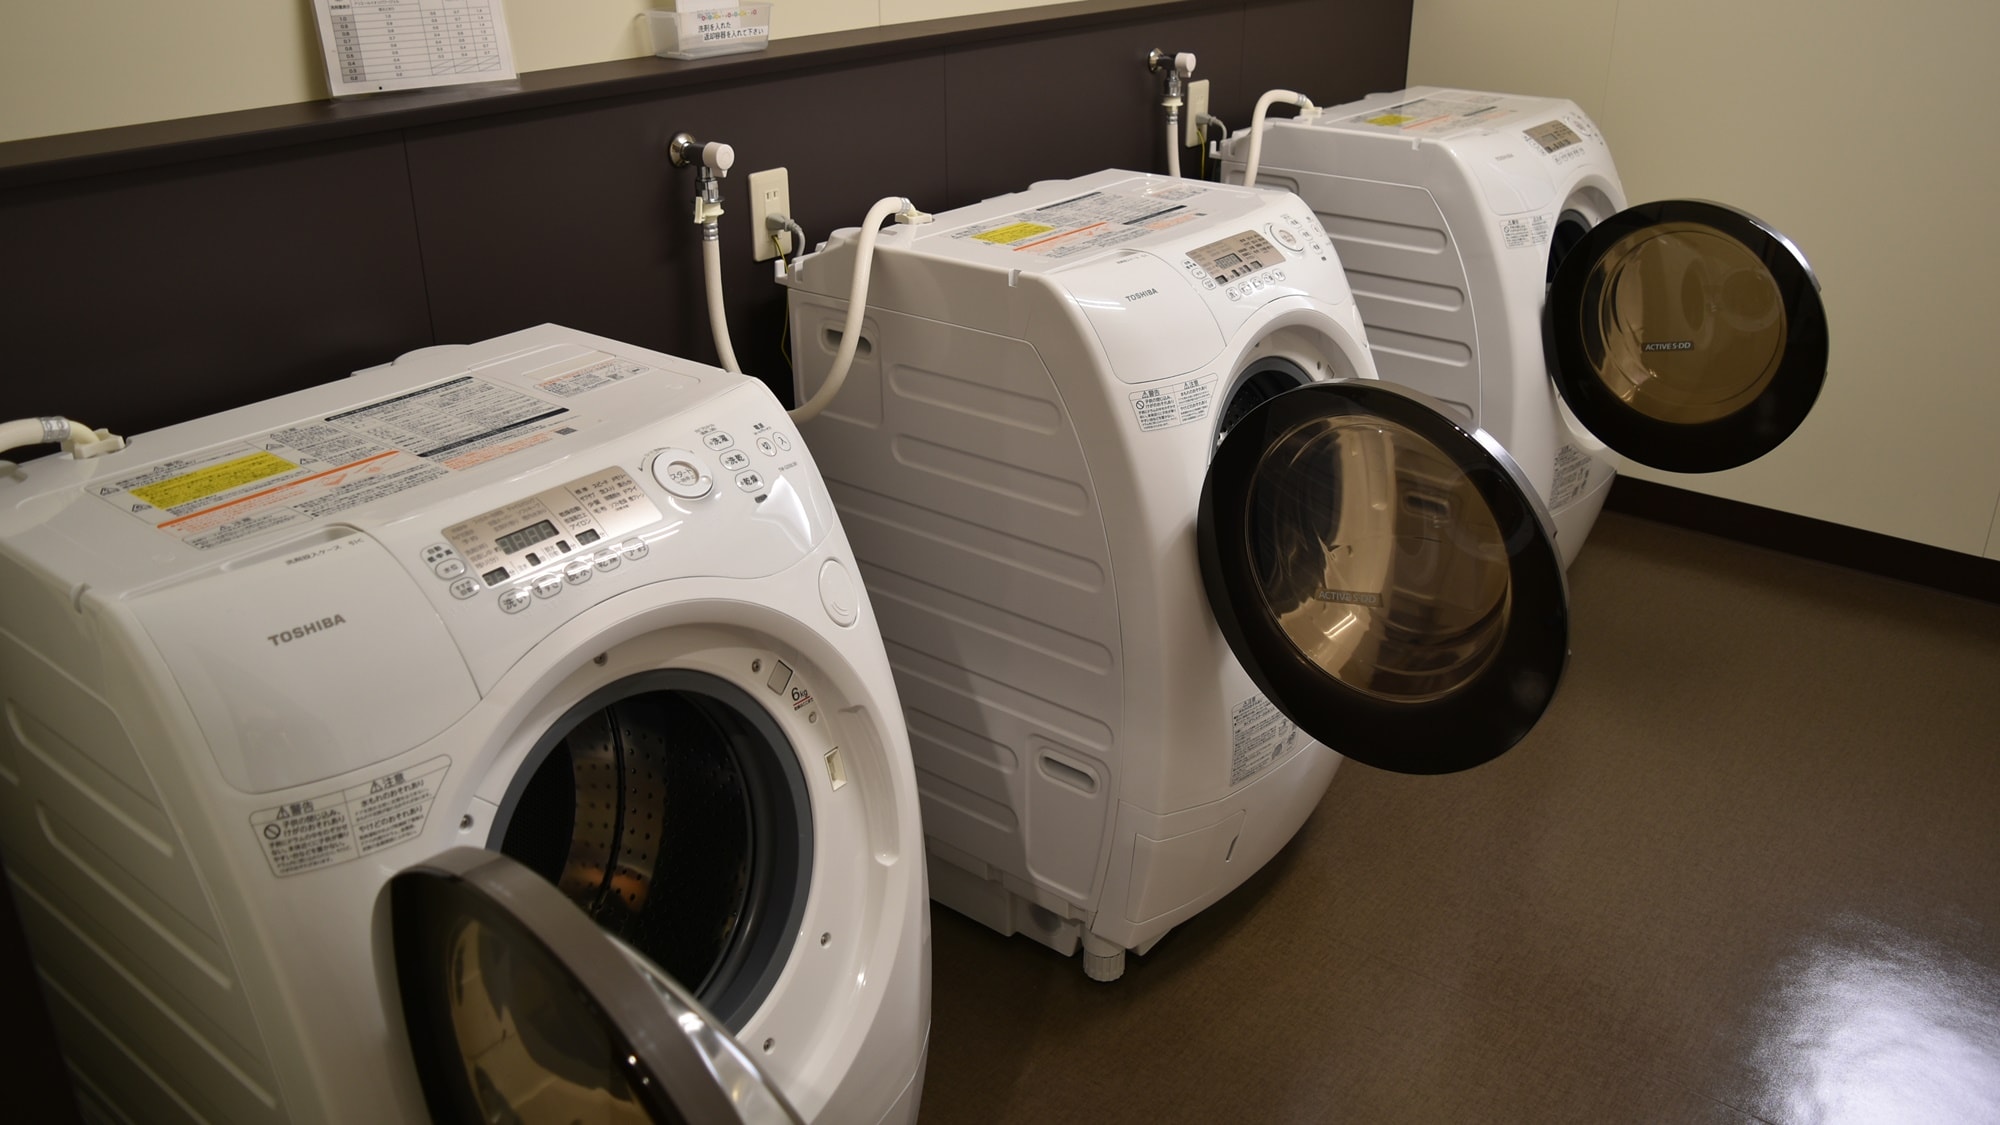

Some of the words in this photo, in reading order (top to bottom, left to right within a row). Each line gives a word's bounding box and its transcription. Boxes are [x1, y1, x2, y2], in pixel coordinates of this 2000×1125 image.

[698, 22, 731, 33] 洗剤を入れた
[704, 28, 764, 41] 返却容器を入れて下さい
[1124, 288, 1158, 302] TOSHIBA
[762, 441, 772, 450] 切
[778, 436, 787, 445] 入
[670, 468, 693, 480] スタート
[569, 519, 592, 530] アイロン
[1319, 591, 1352, 602] ACTIVE
[268, 614, 346, 646] TOSHIBA
[791, 687, 808, 701] 6kg
[382, 773, 404, 789] 注意
[361, 779, 424, 807] 水もれのおそれあり
[290, 800, 314, 816] 警告
[359, 805, 422, 832] やけどのおそれあり
[283, 815, 345, 837] けがのおそれあり
